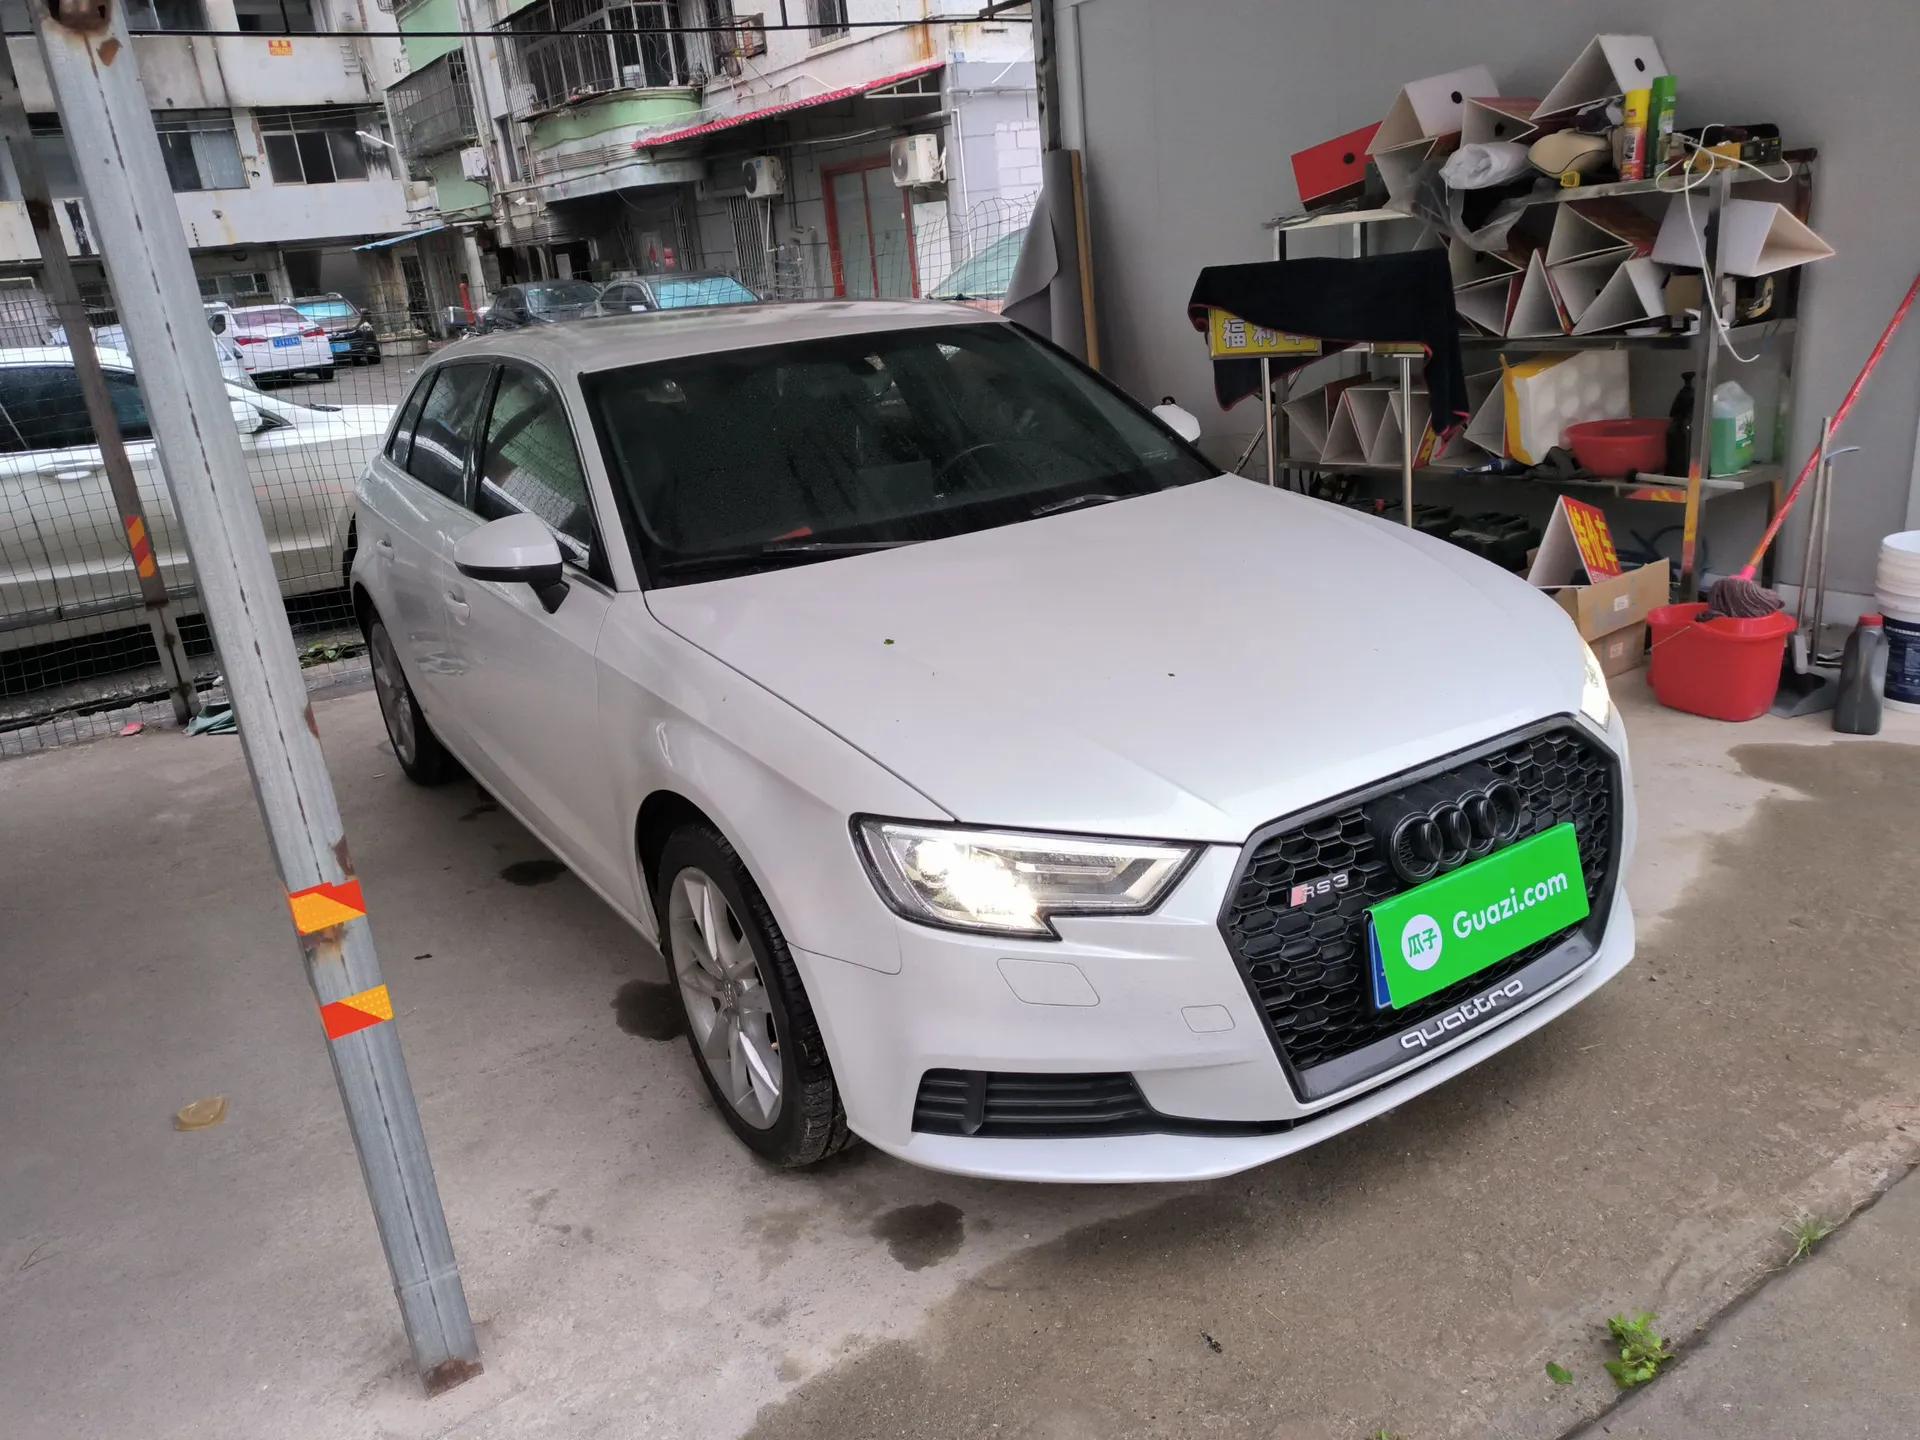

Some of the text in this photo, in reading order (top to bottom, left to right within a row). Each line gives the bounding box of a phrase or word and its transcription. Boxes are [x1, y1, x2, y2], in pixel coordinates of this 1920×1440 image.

[1567, 504, 1618, 573] 特价车
[1453, 872, 1568, 938] Guazi.com
[1407, 927, 1438, 958] 瓜子
[1400, 979, 1524, 1049] quattro
